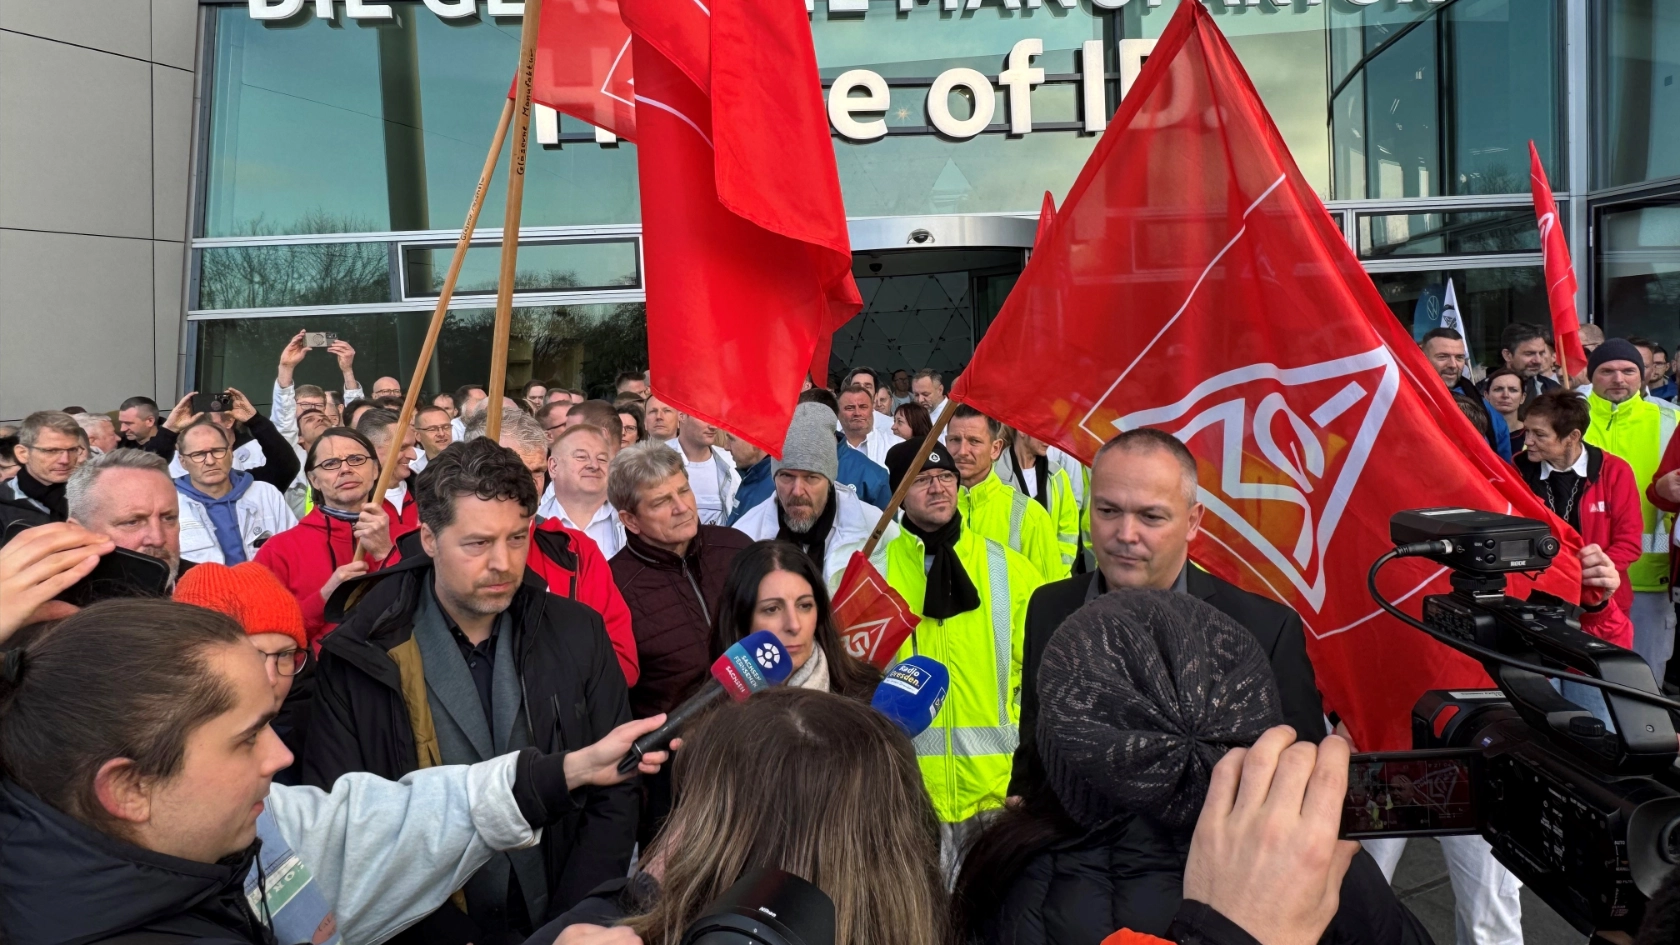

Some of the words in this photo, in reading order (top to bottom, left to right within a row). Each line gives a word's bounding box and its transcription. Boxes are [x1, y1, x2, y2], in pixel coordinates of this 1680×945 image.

[927, 38, 1045, 137] of
[725, 665, 746, 693] SACHSEN
[740, 655, 762, 681] SACHSEN
[898, 665, 921, 678] Radio
